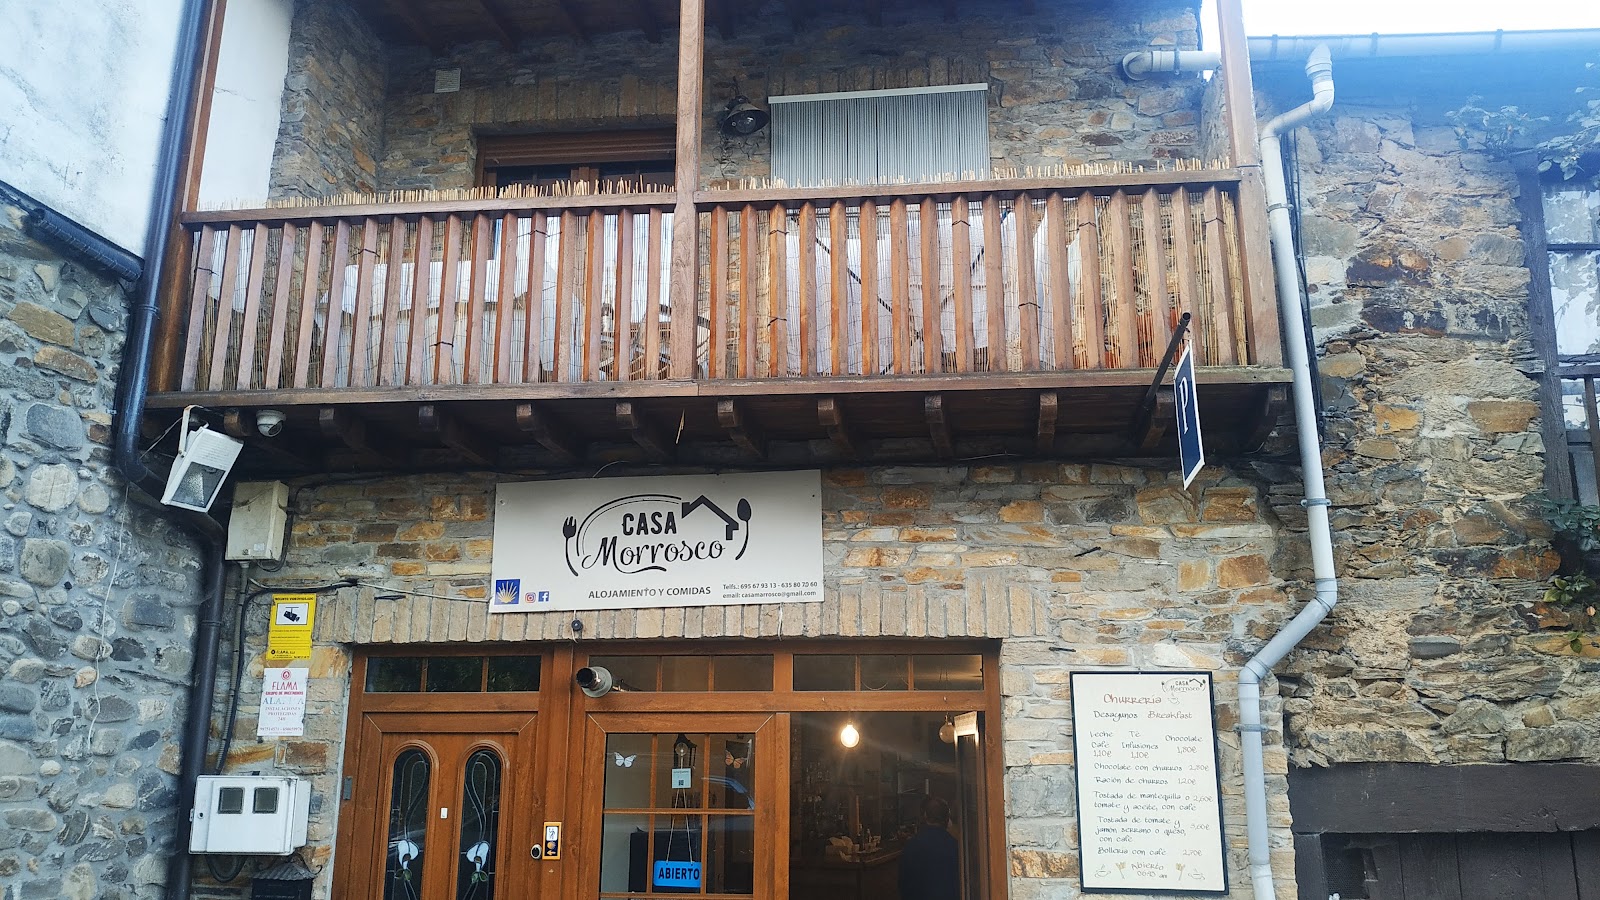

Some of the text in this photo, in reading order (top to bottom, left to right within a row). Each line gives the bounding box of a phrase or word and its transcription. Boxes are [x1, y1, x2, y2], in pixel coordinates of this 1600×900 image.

[1178, 376, 1188, 434] P
[622, 511, 677, 536] CASA
[581, 536, 725, 574] Morrosco
[588, 586, 711, 599] ALOJAMIENTO Y COMIDAS
[272, 682, 298, 690] FLAMA
[1148, 711, 1193, 719] Breakfast
[1090, 730, 1113, 738] Leche
[1122, 742, 1158, 750] Infusiones
[1094, 763, 1131, 771] Chocolate
[1094, 791, 1123, 799] Tostada
[1140, 793, 1181, 801] mantequilla
[1123, 805, 1130, 813] y
[1174, 820, 1181, 829] y
[1131, 862, 1164, 870] Abierto
[658, 868, 700, 880] ABIERTO
